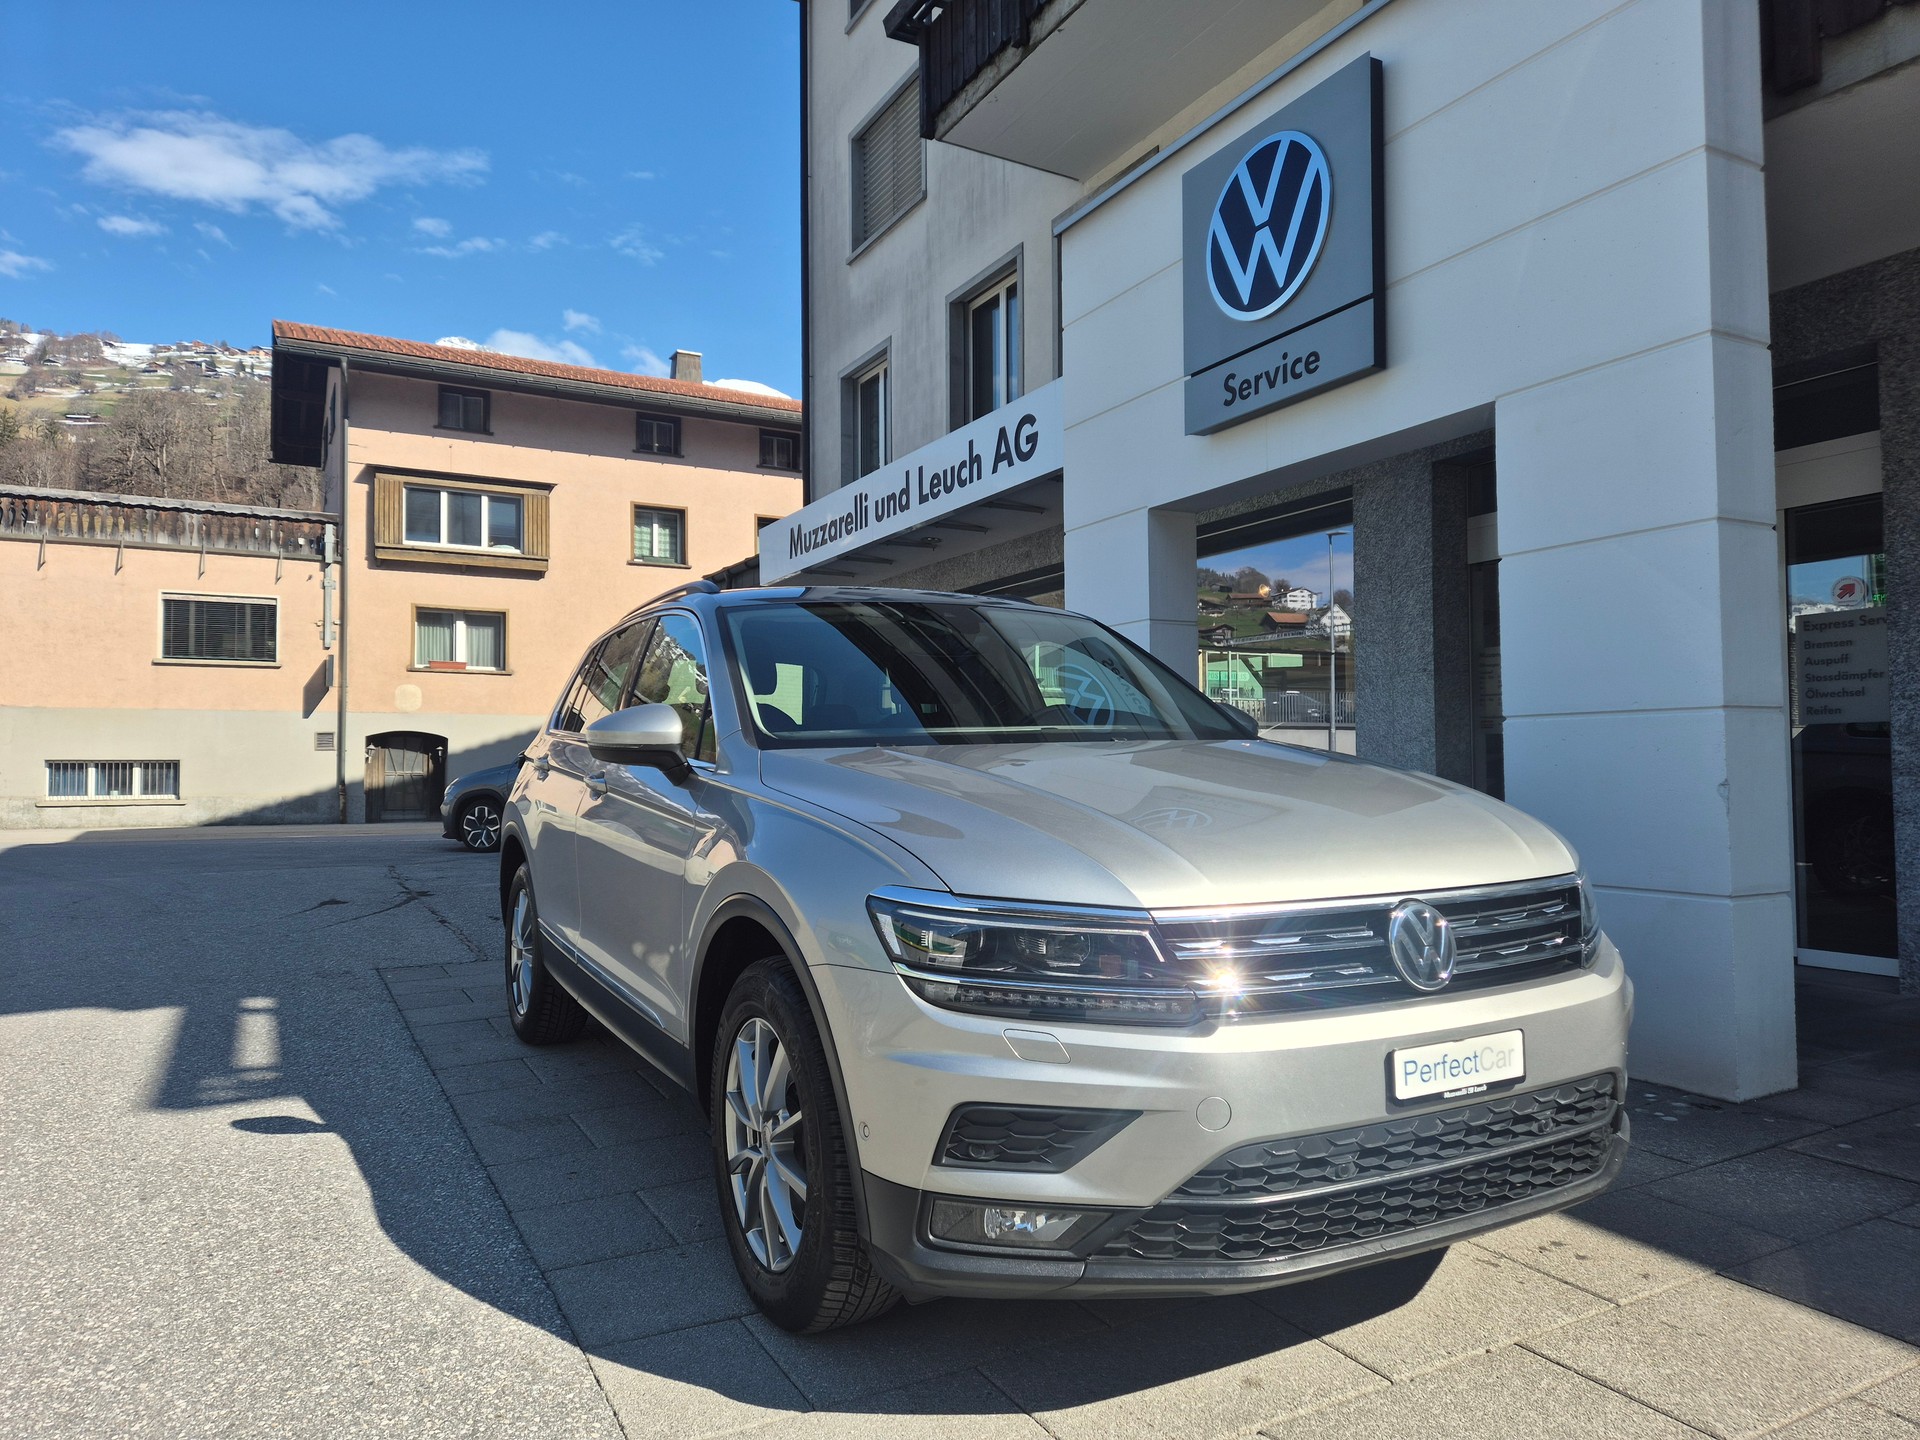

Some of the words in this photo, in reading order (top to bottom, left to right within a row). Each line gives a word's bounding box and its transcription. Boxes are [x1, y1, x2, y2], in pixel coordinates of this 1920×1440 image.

[1223, 350, 1321, 407] Service
[789, 492, 869, 559] Muzzarelli
[874, 470, 910, 522] und
[918, 440, 982, 505] Leuch
[991, 413, 1039, 475] AG
[1803, 619, 1854, 633] Express
[1804, 639, 1852, 650] Bremsen
[1804, 654, 1849, 667] Auspuff
[1805, 669, 1884, 683] Stossdämpfer
[1805, 687, 1865, 699] Ölwechsel
[1806, 706, 1841, 716] Reifen
[1403, 1047, 1515, 1086] PerfectCar
